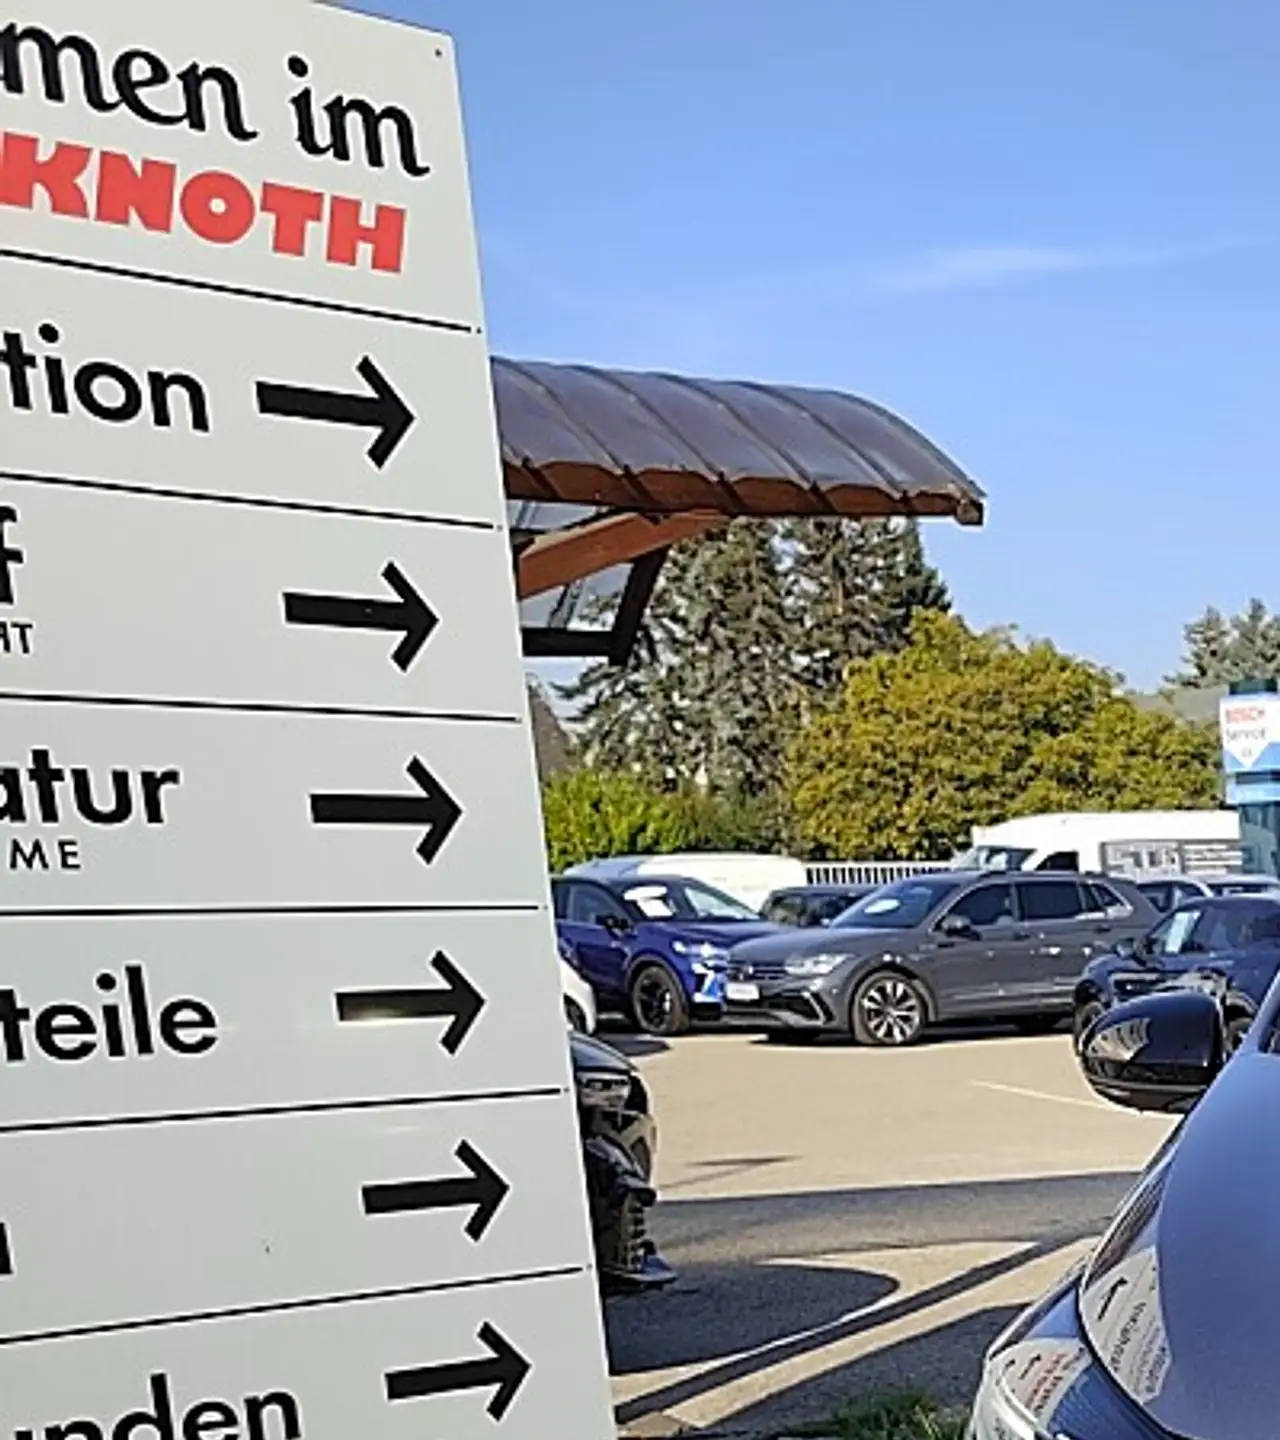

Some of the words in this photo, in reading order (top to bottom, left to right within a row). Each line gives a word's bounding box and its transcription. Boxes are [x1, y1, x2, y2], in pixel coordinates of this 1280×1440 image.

[288, 56, 430, 176] im
[0, 132, 407, 273] KNOTH
[0, 322, 209, 432] tion
[0, 965, 219, 1063] teile
